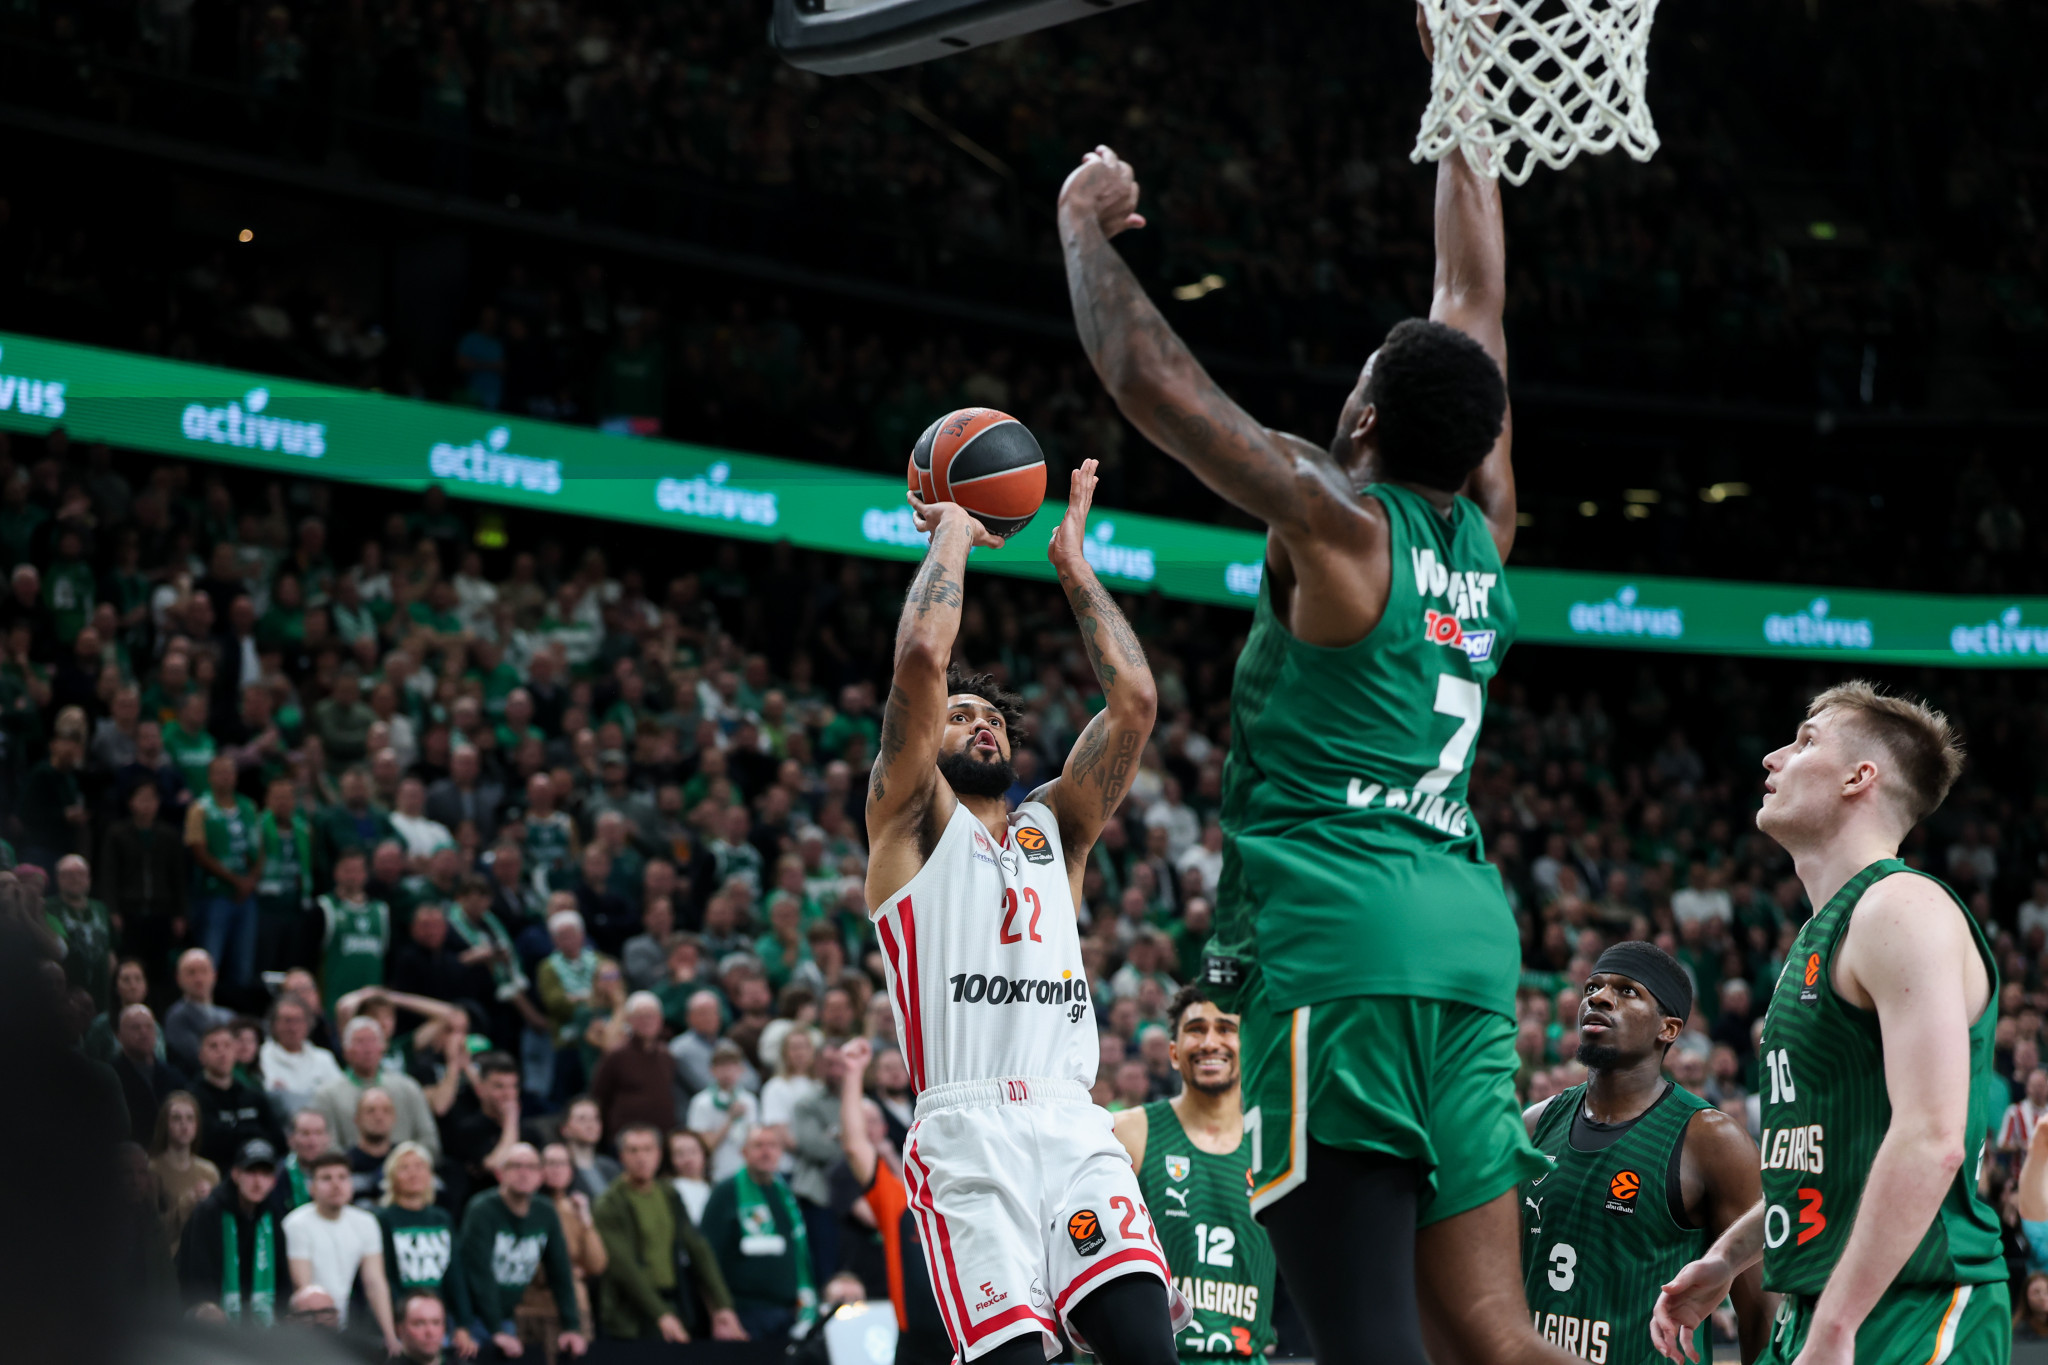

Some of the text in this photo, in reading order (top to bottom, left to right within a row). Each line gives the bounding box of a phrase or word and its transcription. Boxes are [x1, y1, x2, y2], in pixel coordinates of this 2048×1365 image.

[182, 387, 326, 457] activus
[429, 425, 562, 494] activus
[656, 460, 777, 526] activus
[1569, 585, 1683, 639] activus
[1764, 597, 1873, 650] activus
[1950, 605, 2048, 656] activu
[1433, 672, 1483, 797] 7
[1000, 887, 1042, 944] 22
[950, 969, 1087, 1004] 100xronia
[1067, 1003, 1087, 1023] .gr
[1766, 1048, 1796, 1104] 10
[1195, 1223, 1235, 1268] 12
[1548, 1242, 1577, 1292] 3
[975, 1292, 1008, 1312] FlexCar
